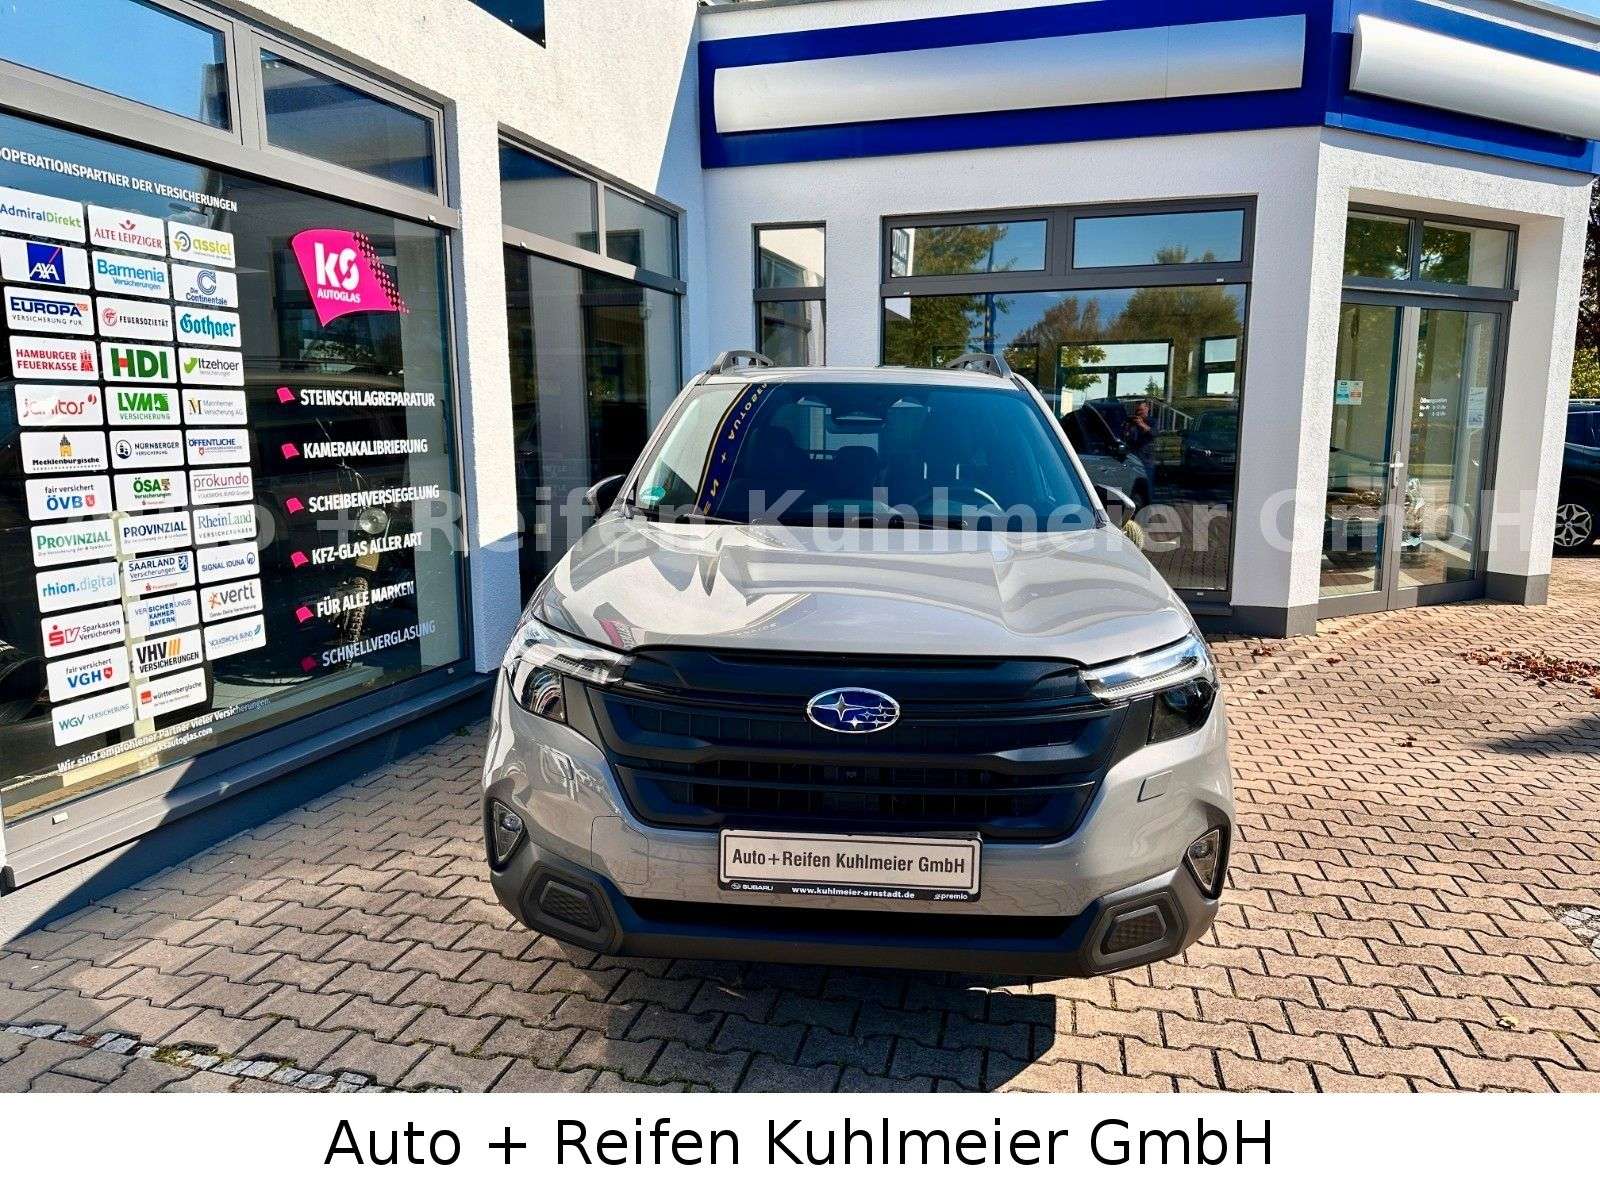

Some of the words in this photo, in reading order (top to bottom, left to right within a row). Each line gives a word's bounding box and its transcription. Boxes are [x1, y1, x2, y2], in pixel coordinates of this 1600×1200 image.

[0, 147, 129, 189] OPERATIONSPARTNER
[131, 178, 152, 193] DER
[153, 182, 238, 212] VERSICHERUNGEN
[0, 203, 82, 228] AdmiralDirekt
[94, 227, 116, 240] ALTE
[118, 231, 163, 249] LEIPZIGER
[29, 262, 60, 281] AXA
[97, 258, 165, 284] Barmenia
[113, 276, 162, 291] Versicherungen
[186, 293, 228, 306] Continentale
[317, 287, 361, 303] AUTOGLAS
[10, 296, 82, 317] EUROPA
[179, 312, 237, 340] Gothaer
[16, 349, 77, 360] HAMBURGER
[111, 347, 169, 379] HDI
[198, 357, 240, 371] Itzehoer
[17, 360, 78, 371] FEUERKASSE
[118, 392, 153, 412] LVM
[300, 388, 436, 407] STEINSCHLAGREPARATUR
[120, 412, 170, 420] VERSICHERUNG
[303, 438, 429, 459] KAMERAKALIBRIERUNG
[32, 456, 100, 466] Mecklenburgische
[44, 485, 57, 494] fair
[58, 484, 94, 493] versichert
[133, 477, 161, 493] ÖSA
[193, 472, 249, 491] prokundo
[46, 494, 83, 511] ÖVB
[308, 484, 440, 513] SCHEIBENVERSIEGELUNG
[198, 510, 252, 529] RheinLand
[123, 521, 188, 538] PROVINZIAL
[37, 530, 112, 550] PROVINZIAL
[311, 540, 368, 565] KFZ-GLAS
[369, 534, 403, 554] ALLER
[403, 531, 424, 547] ART
[128, 557, 176, 572] SAARLAND
[129, 567, 176, 579] Versicherungen
[42, 573, 117, 597] rhion.digital
[219, 582, 255, 605] verti
[316, 594, 341, 618] FÜR
[342, 589, 370, 611] ALLE
[371, 580, 415, 604] MARKEN
[82, 620, 120, 633] Sparkassen
[149, 617, 176, 627] BAYERN
[79, 627, 121, 641] Versicherung
[321, 620, 436, 667] SCHNELLVERGLASUNG
[136, 641, 168, 664] VHV
[78, 658, 112, 671] versichert
[139, 651, 200, 674] VERSICHERUNGEN
[67, 669, 102, 689] VGH
[58, 714, 85, 731] WGV
[57, 759, 76, 773] Wir
[77, 751, 99, 767] sind
[159, 721, 190, 740] Partner
[836, 852, 914, 872] Kuhlmeier
[918, 856, 965, 874] GmbH
[742, 883, 774, 891] SUBARU
[791, 886, 916, 900] www.kuhlmeier-arnstadt.de
